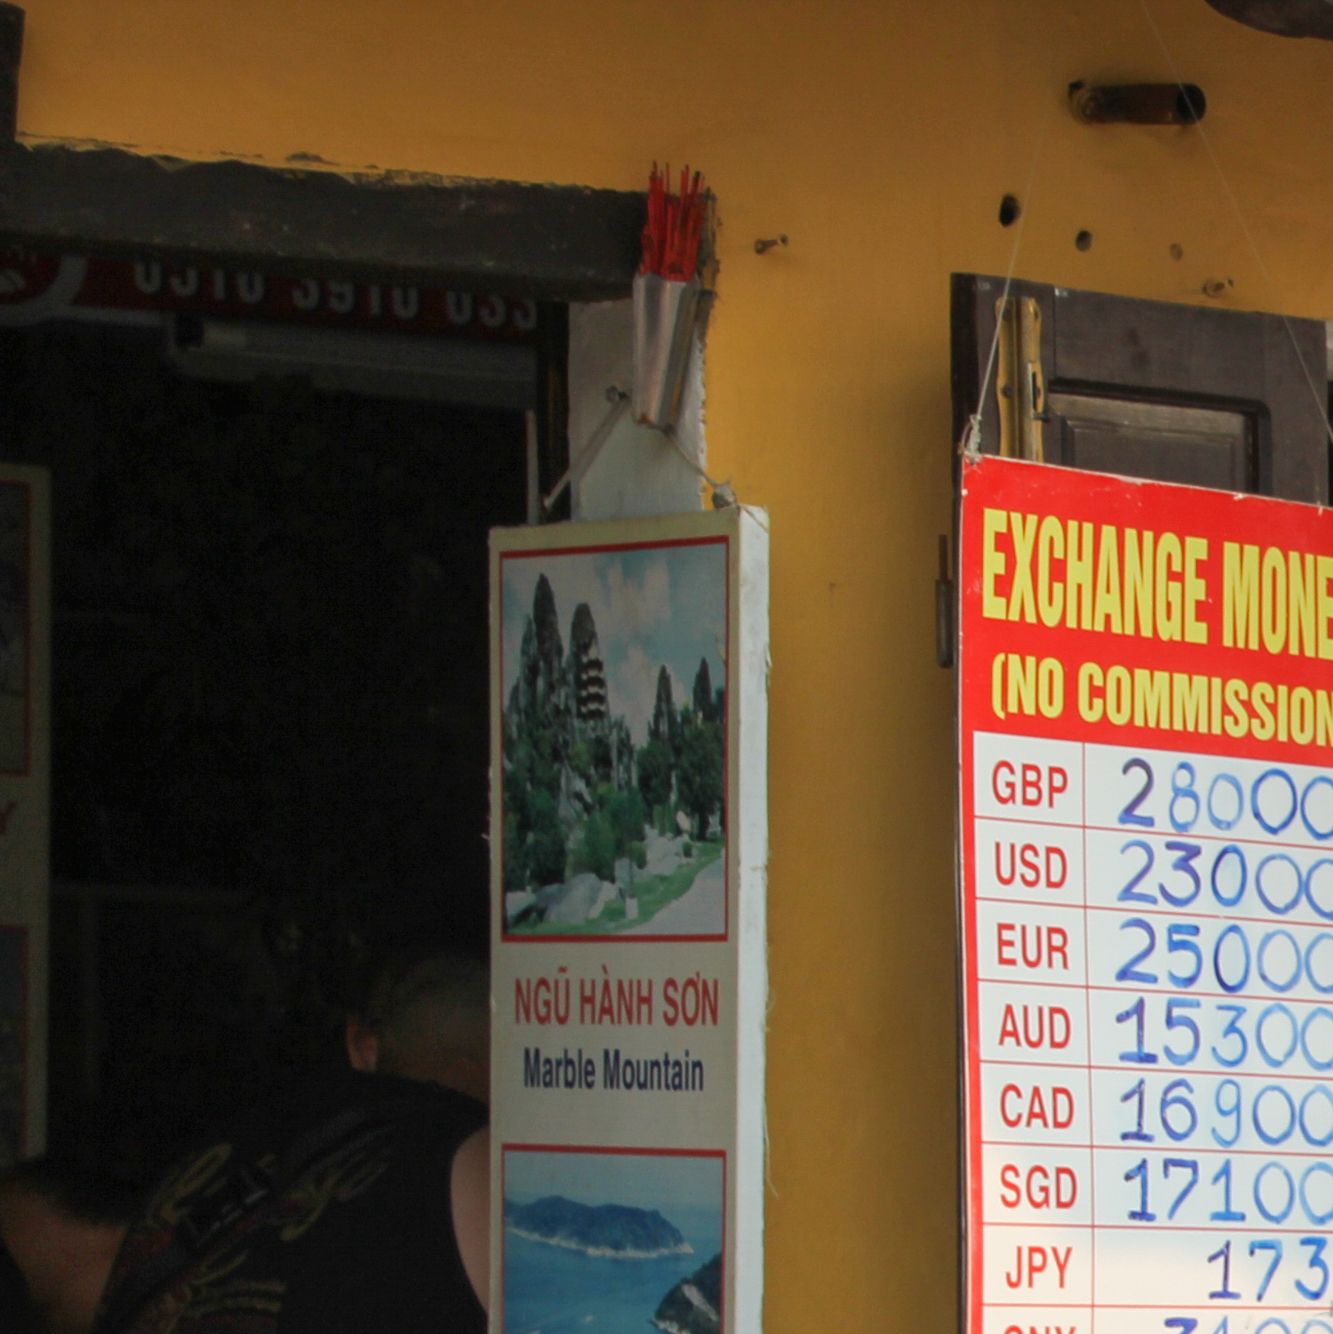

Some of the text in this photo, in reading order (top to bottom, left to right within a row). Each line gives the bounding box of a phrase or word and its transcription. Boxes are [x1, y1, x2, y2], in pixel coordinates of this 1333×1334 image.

[981, 507, 1209, 645] EXCHANGE
[990, 651, 1065, 721] (NO
[992, 760, 1068, 809] GBP
[994, 841, 1068, 889] USD
[996, 923, 1069, 970] EUR
[514, 964, 719, 1027] NGŨ HÀNH SƠN
[998, 1004, 1072, 1049] AUD
[523, 1047, 704, 1092] Marble Mountain
[1000, 1083, 1075, 1130] CAD
[1000, 1163, 1078, 1210] SGD
[1005, 1236, 1330, 1302] JPY 173
